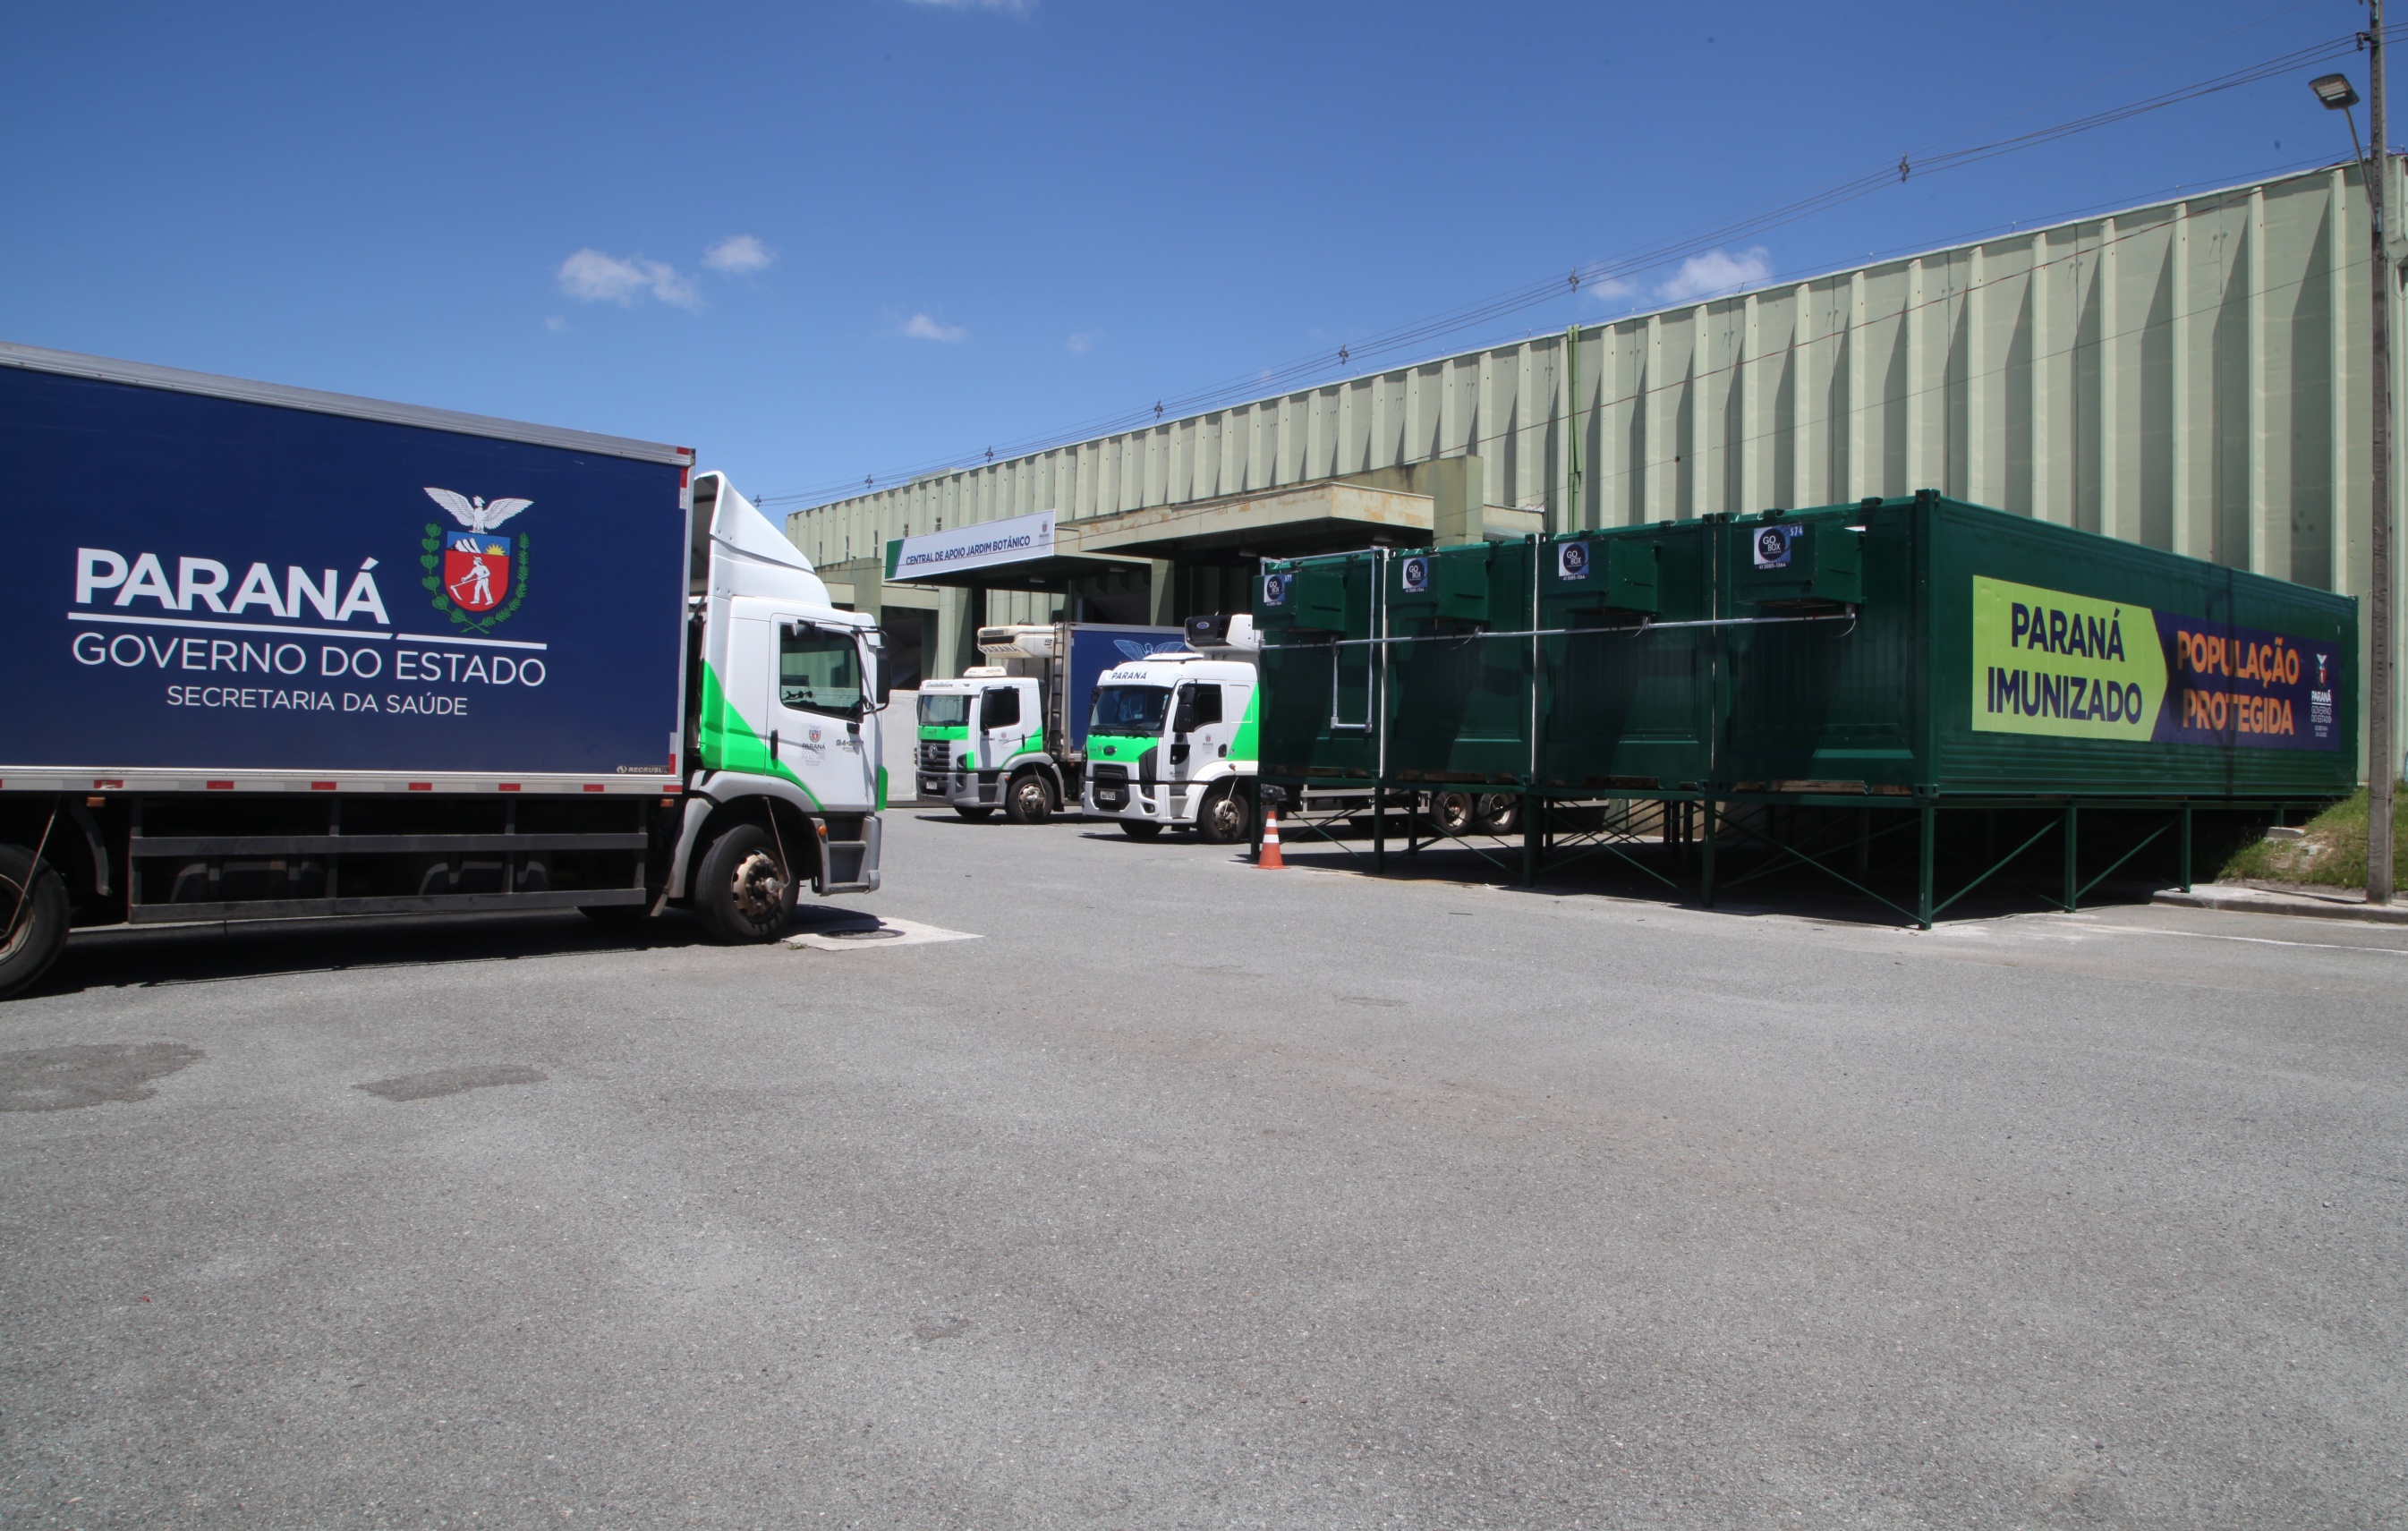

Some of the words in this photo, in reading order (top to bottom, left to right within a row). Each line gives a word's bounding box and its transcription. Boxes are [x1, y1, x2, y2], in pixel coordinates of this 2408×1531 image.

[1763, 536, 1776, 544] GO
[1768, 543, 1781, 551] BOX
[906, 554, 933, 566] CENTRAL
[935, 551, 944, 561] DE
[944, 547, 966, 560] APOIO
[966, 542, 991, 556] JARDIM
[993, 536, 1030, 551] BOTÂNICO
[1566, 550, 1578, 558] GO
[1570, 557, 1581, 565] BOX
[1412, 571, 1421, 579] BOX
[76, 548, 390, 625] PARANÁ
[2012, 602, 2125, 662] PARANÁ
[73, 633, 306, 674] GOVERNO
[321, 646, 382, 678] DO
[396, 651, 546, 685] ESTADO
[2177, 630, 2300, 689] POPULAÇÃO
[166, 685, 335, 711] SECRETARIA
[343, 693, 379, 712] DA
[386, 693, 467, 715] SAÚDE
[1987, 666, 2142, 725] IMUNIZADO
[2311, 690, 2331, 702] PARANÁ
[2183, 688, 2294, 735] PROTEGIDA
[2311, 705, 2331, 715] GOVERNO
[2318, 715, 2331, 723] ESTADO
